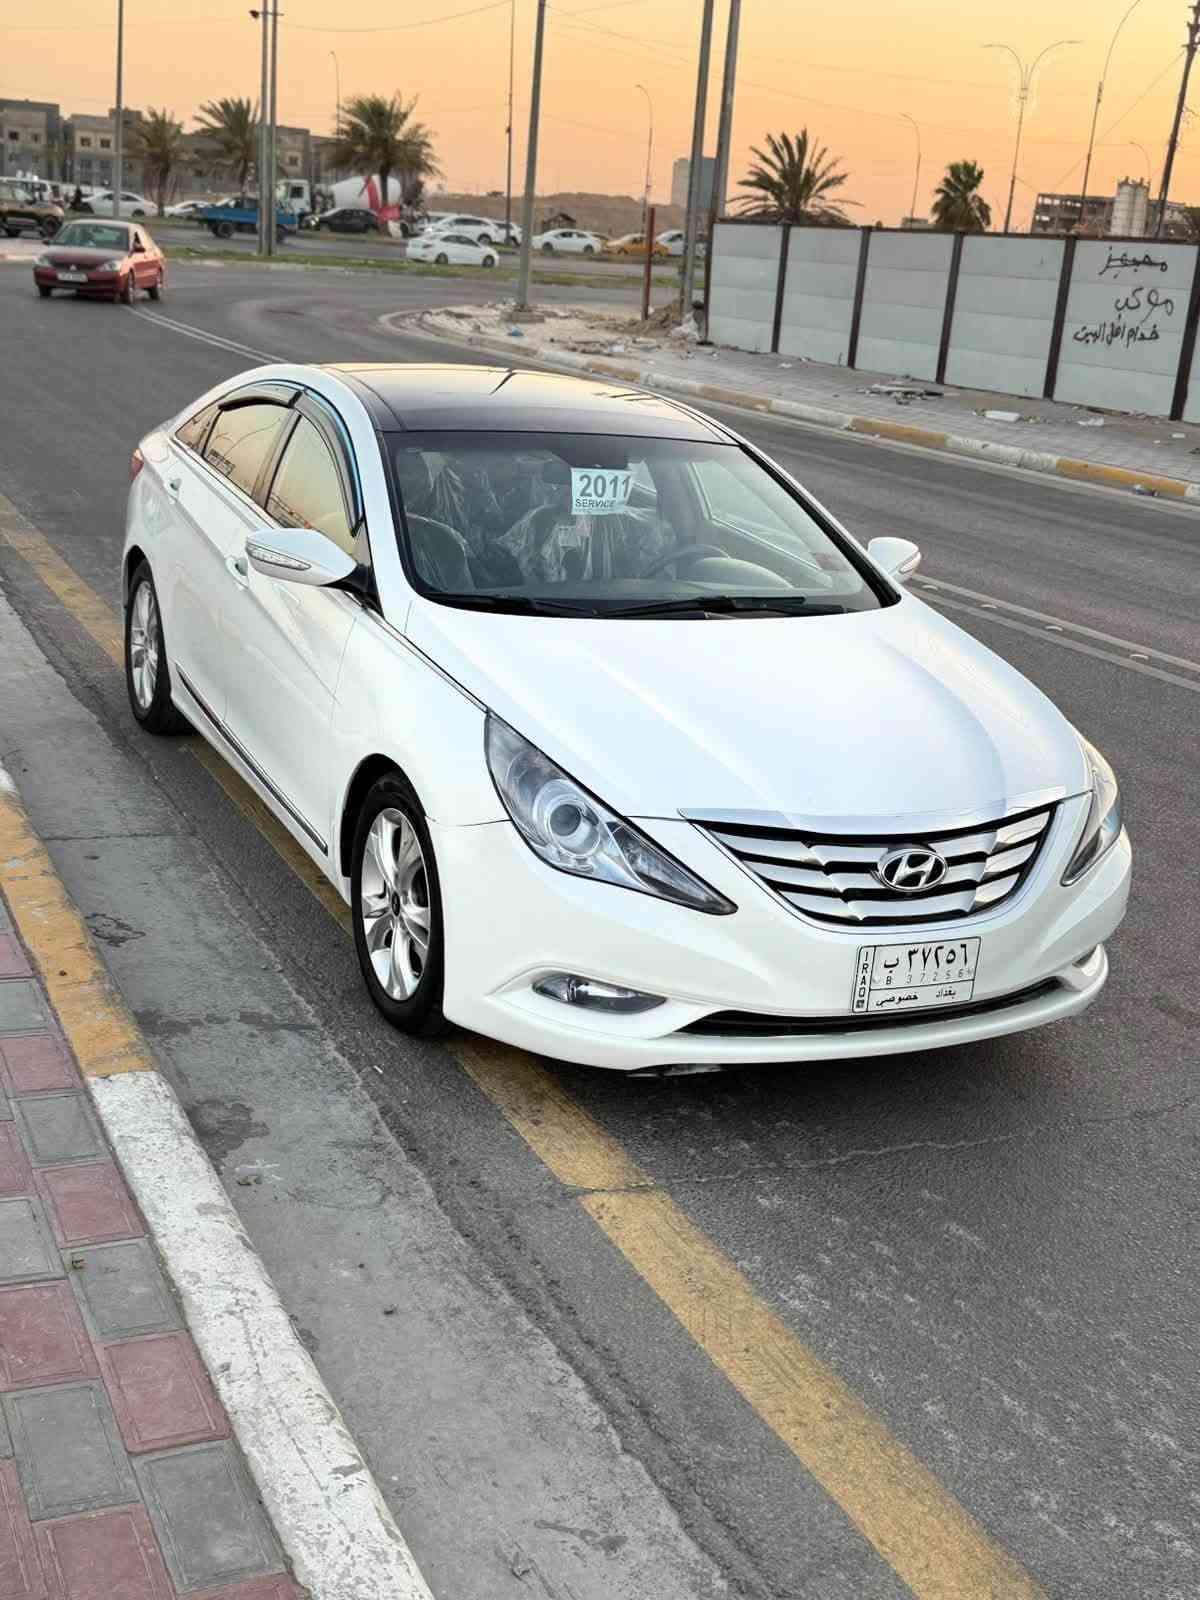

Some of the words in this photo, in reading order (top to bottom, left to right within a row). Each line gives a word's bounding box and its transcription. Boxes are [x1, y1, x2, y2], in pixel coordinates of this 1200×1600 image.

[1114, 286, 1174, 324] موكب
[1073, 320, 1107, 344] البيت
[1126, 323, 1160, 349] خدام
[579, 474, 631, 498] 2011
[575, 498, 616, 508] SERVICE
[883, 957, 900, 974] ب
